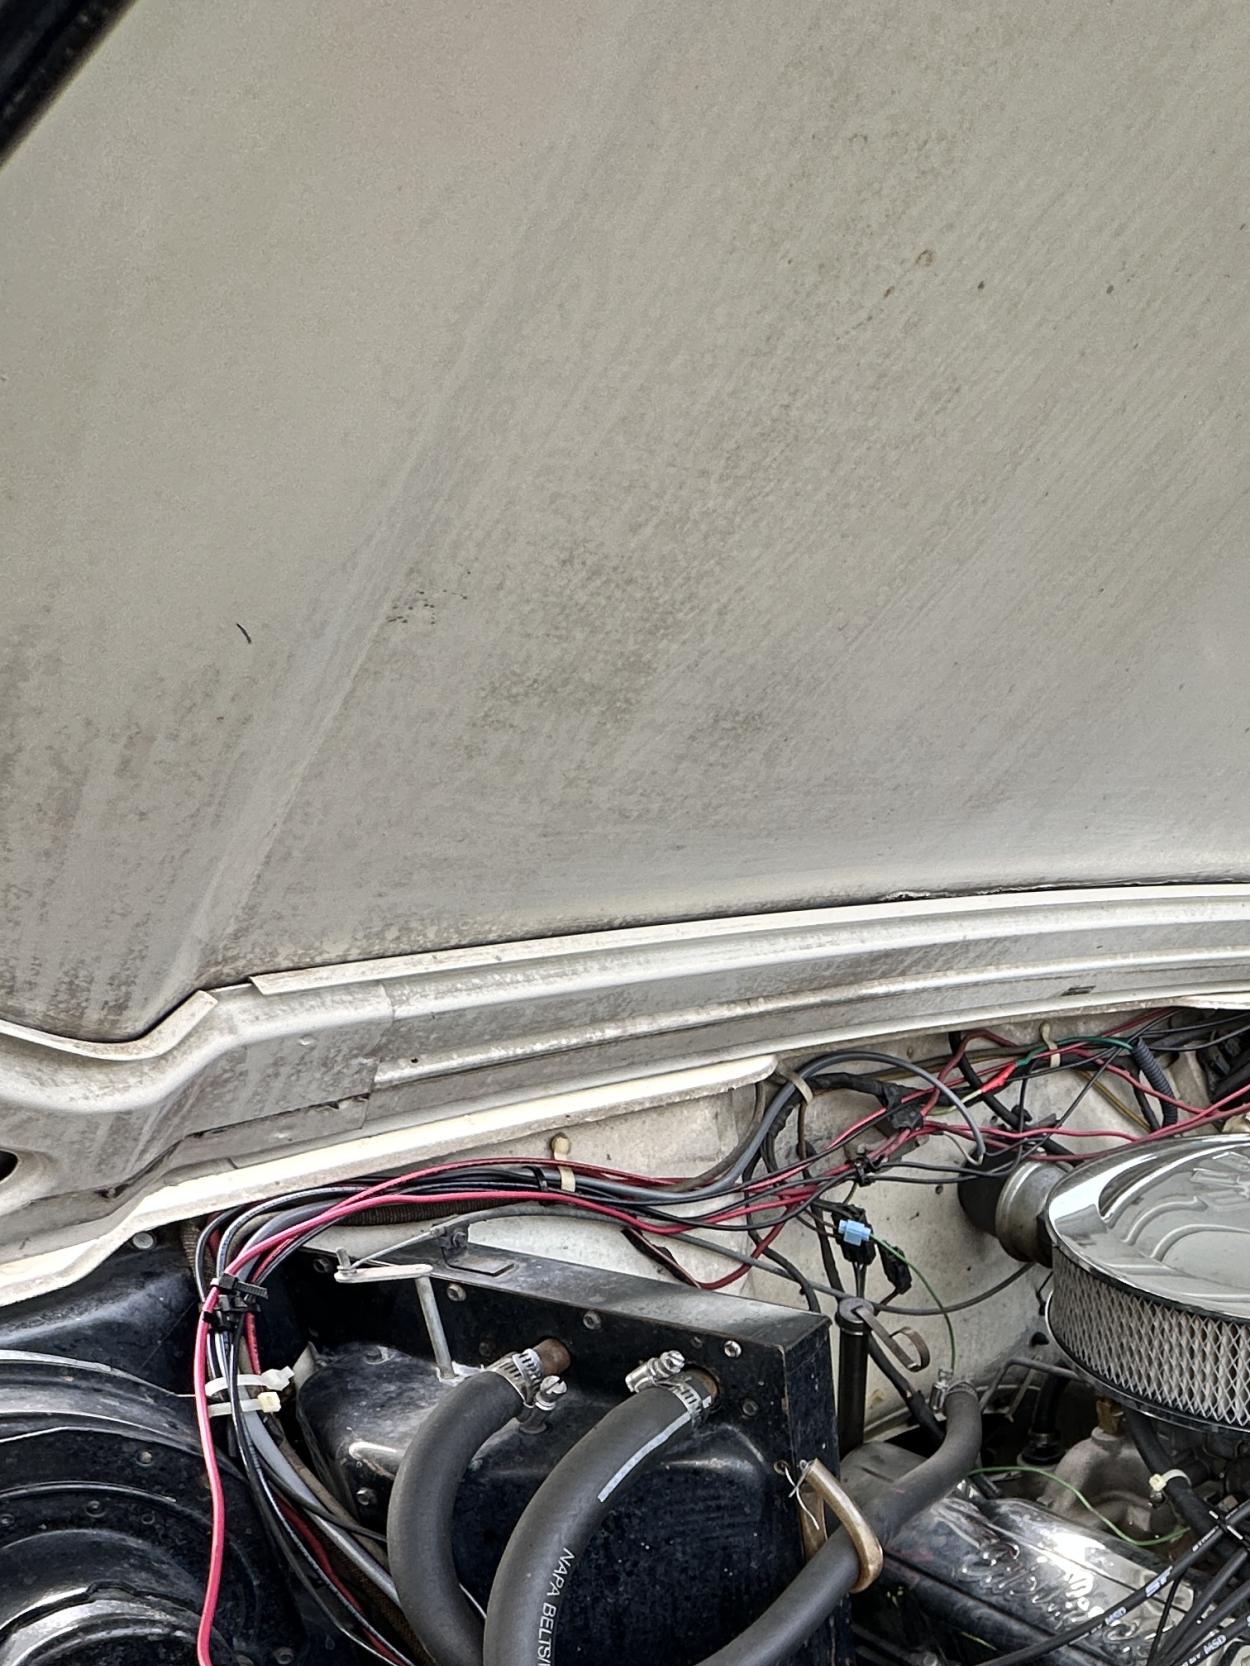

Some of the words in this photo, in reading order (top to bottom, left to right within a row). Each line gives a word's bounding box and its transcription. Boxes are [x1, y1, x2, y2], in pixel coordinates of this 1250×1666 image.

[546, 1545, 573, 1596] NAPA
[1104, 1606, 1126, 1626] MSD
[1203, 1630, 1226, 1657] MSD
